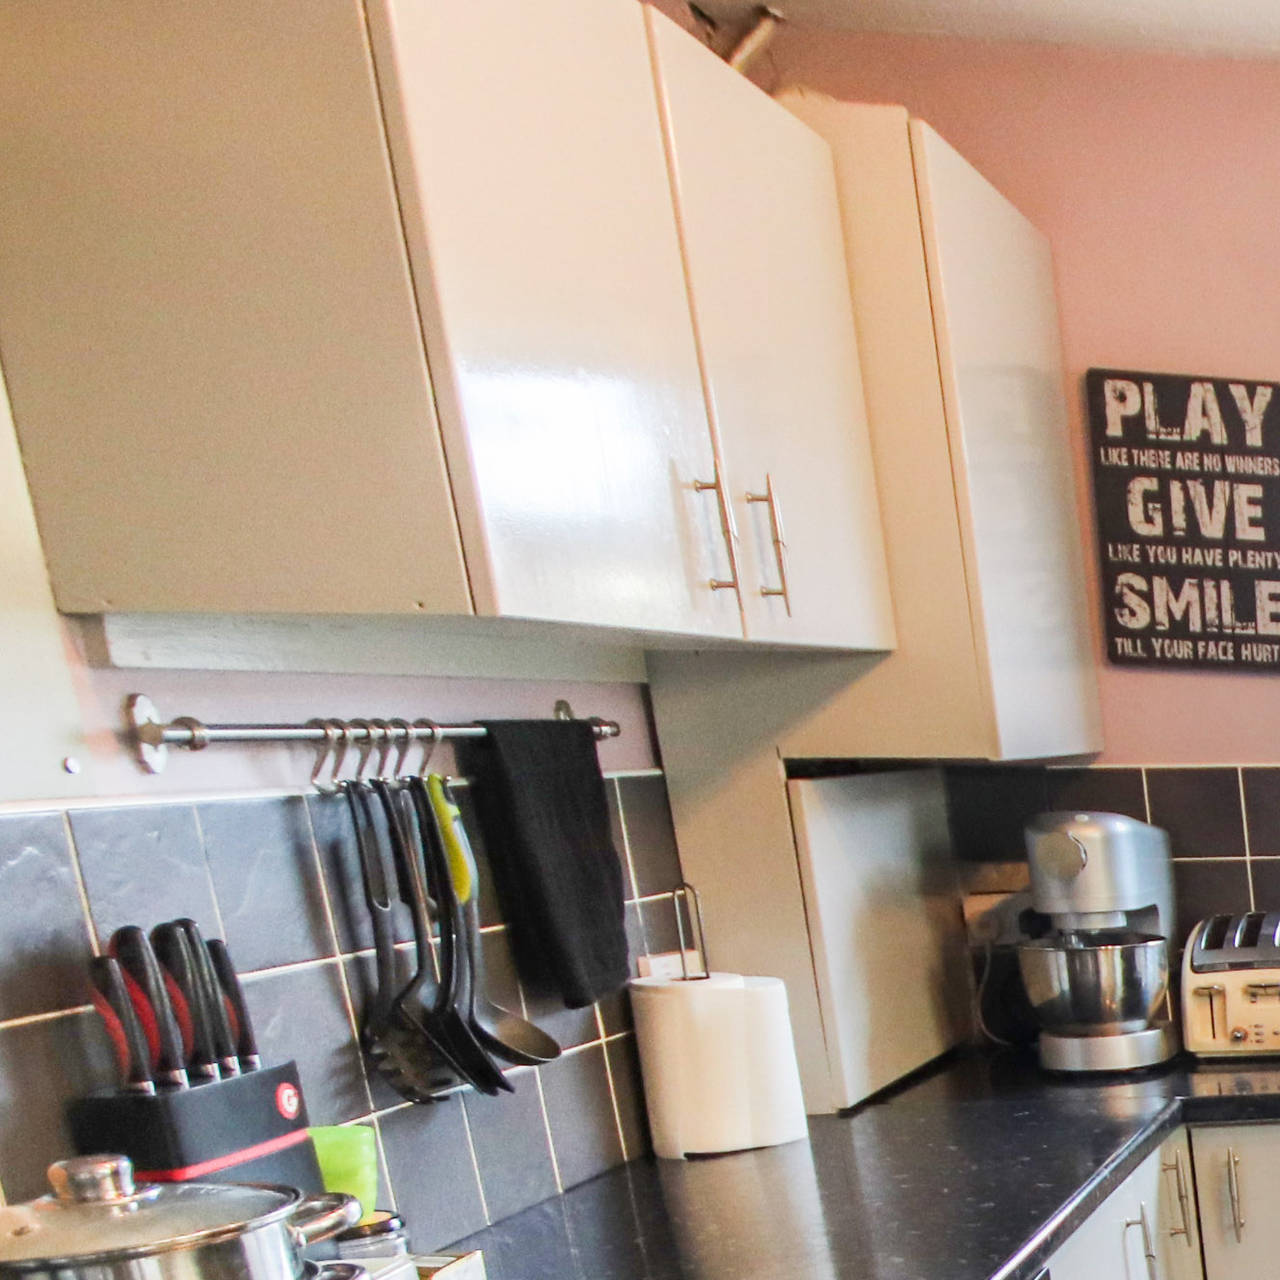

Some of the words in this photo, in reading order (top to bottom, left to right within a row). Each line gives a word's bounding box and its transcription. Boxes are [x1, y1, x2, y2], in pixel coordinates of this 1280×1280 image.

[1104, 379, 1272, 447] PLAY
[1100, 447, 1128, 466] LIKE
[1131, 448, 1171, 470] THERE
[1175, 451, 1200, 471] ARE
[1203, 453, 1222, 472] NO
[1225, 454, 1280, 476] WINNERS
[1127, 475, 1265, 541] GIVE
[1108, 543, 1140, 562] LIKE
[1146, 544, 1177, 564] YOU
[1182, 547, 1223, 567] HAVE
[1114, 637, 1146, 657] TILL
[1151, 637, 1194, 660] YOUR
[1198, 640, 1234, 660] FACE
[281, 1088, 298, 1113] G
